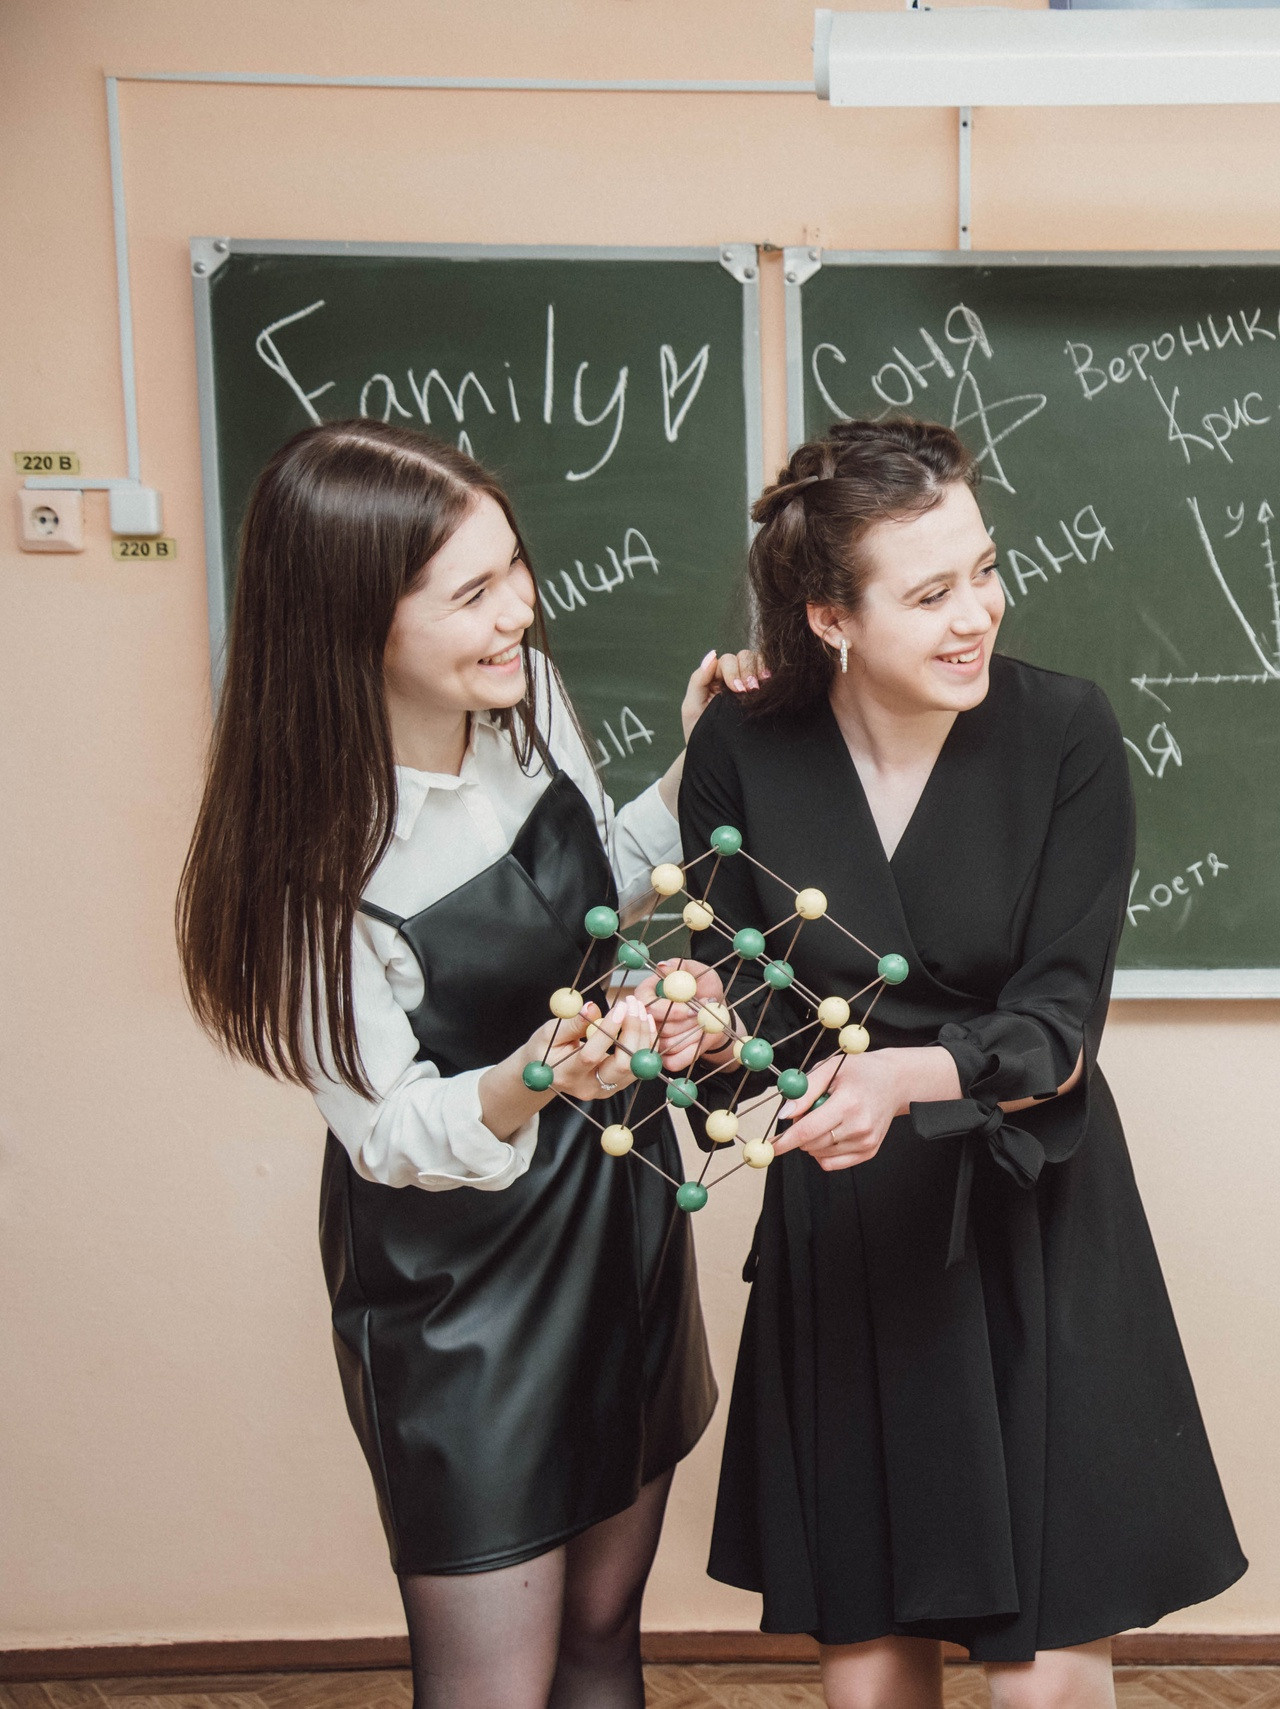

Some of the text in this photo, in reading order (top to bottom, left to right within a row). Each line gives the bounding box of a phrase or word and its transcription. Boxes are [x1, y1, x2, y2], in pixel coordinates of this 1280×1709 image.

[255, 300, 628, 482] Family
[23, 456, 53, 471] 220
[119, 541, 150, 557] 220
